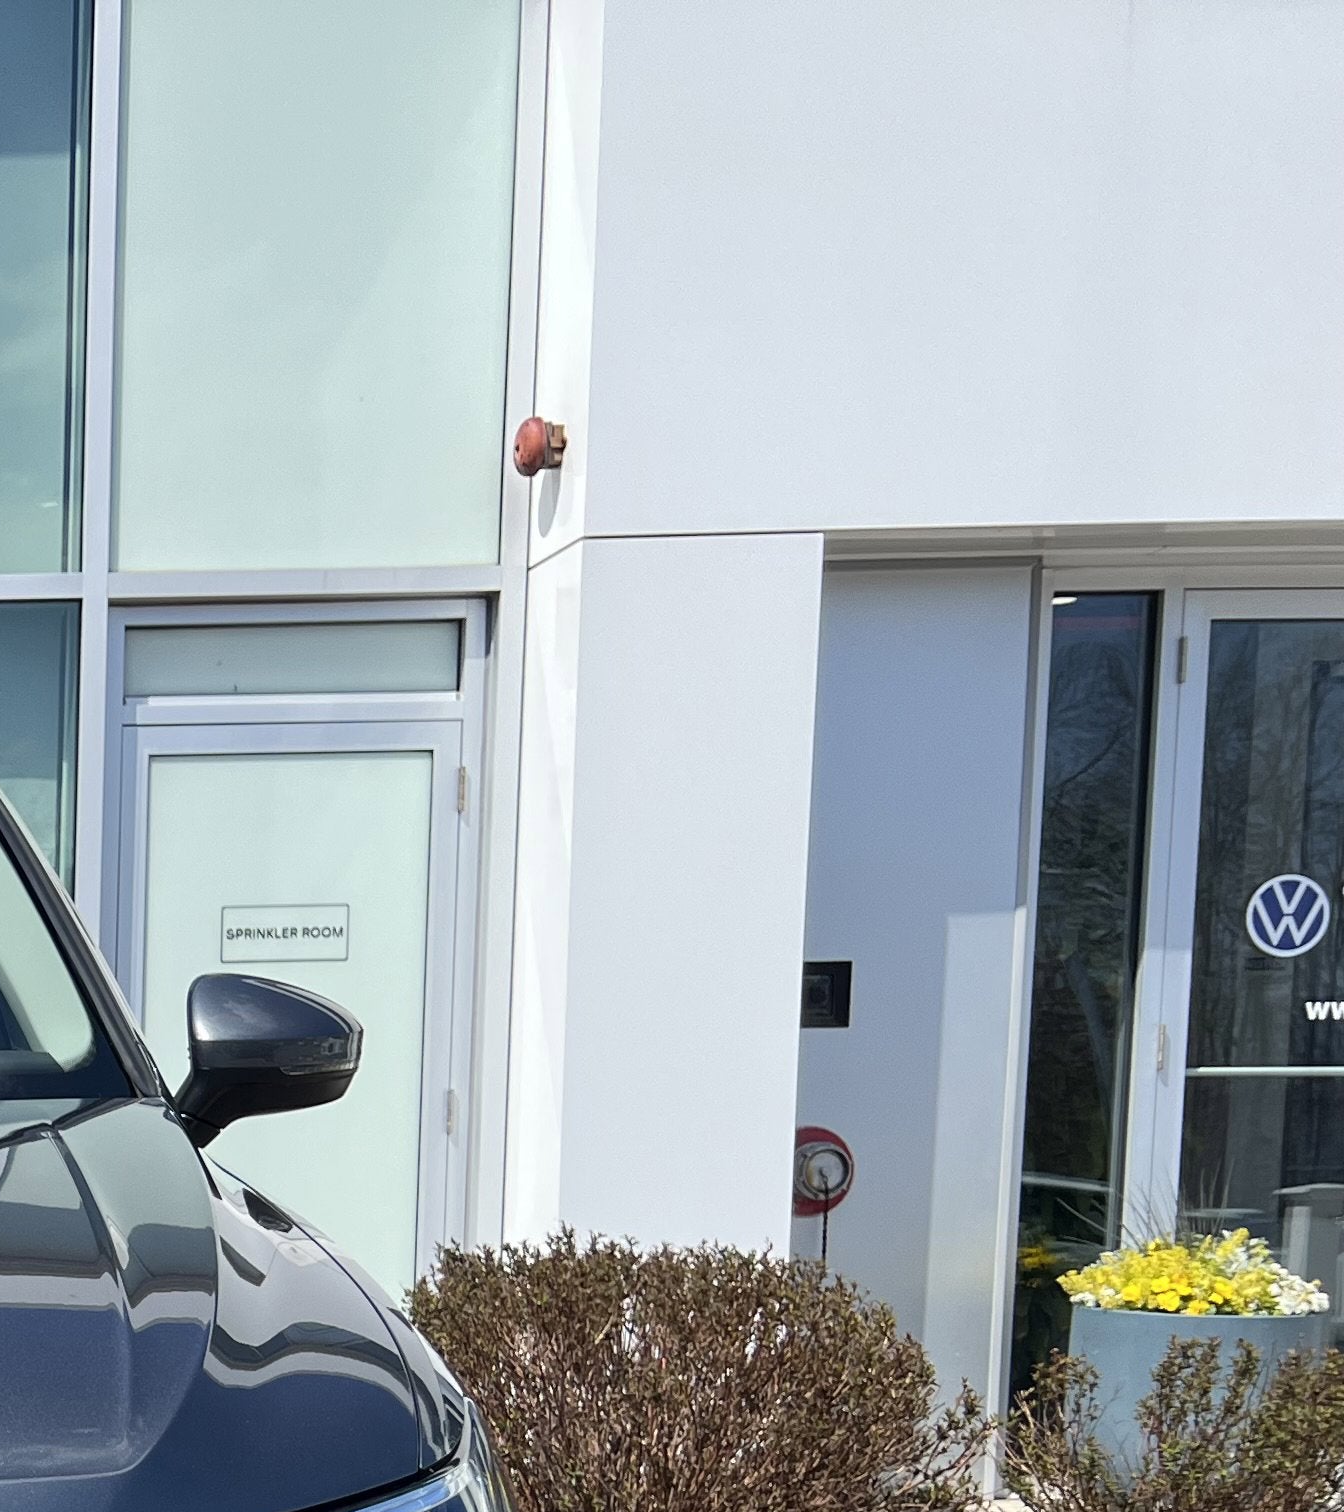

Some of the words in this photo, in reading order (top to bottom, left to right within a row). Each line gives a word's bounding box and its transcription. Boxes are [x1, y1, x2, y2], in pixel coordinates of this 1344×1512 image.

[226, 928, 298, 940] SPRINKLER
[302, 927, 343, 938] ROOM
[1246, 874, 1330, 957] VW
